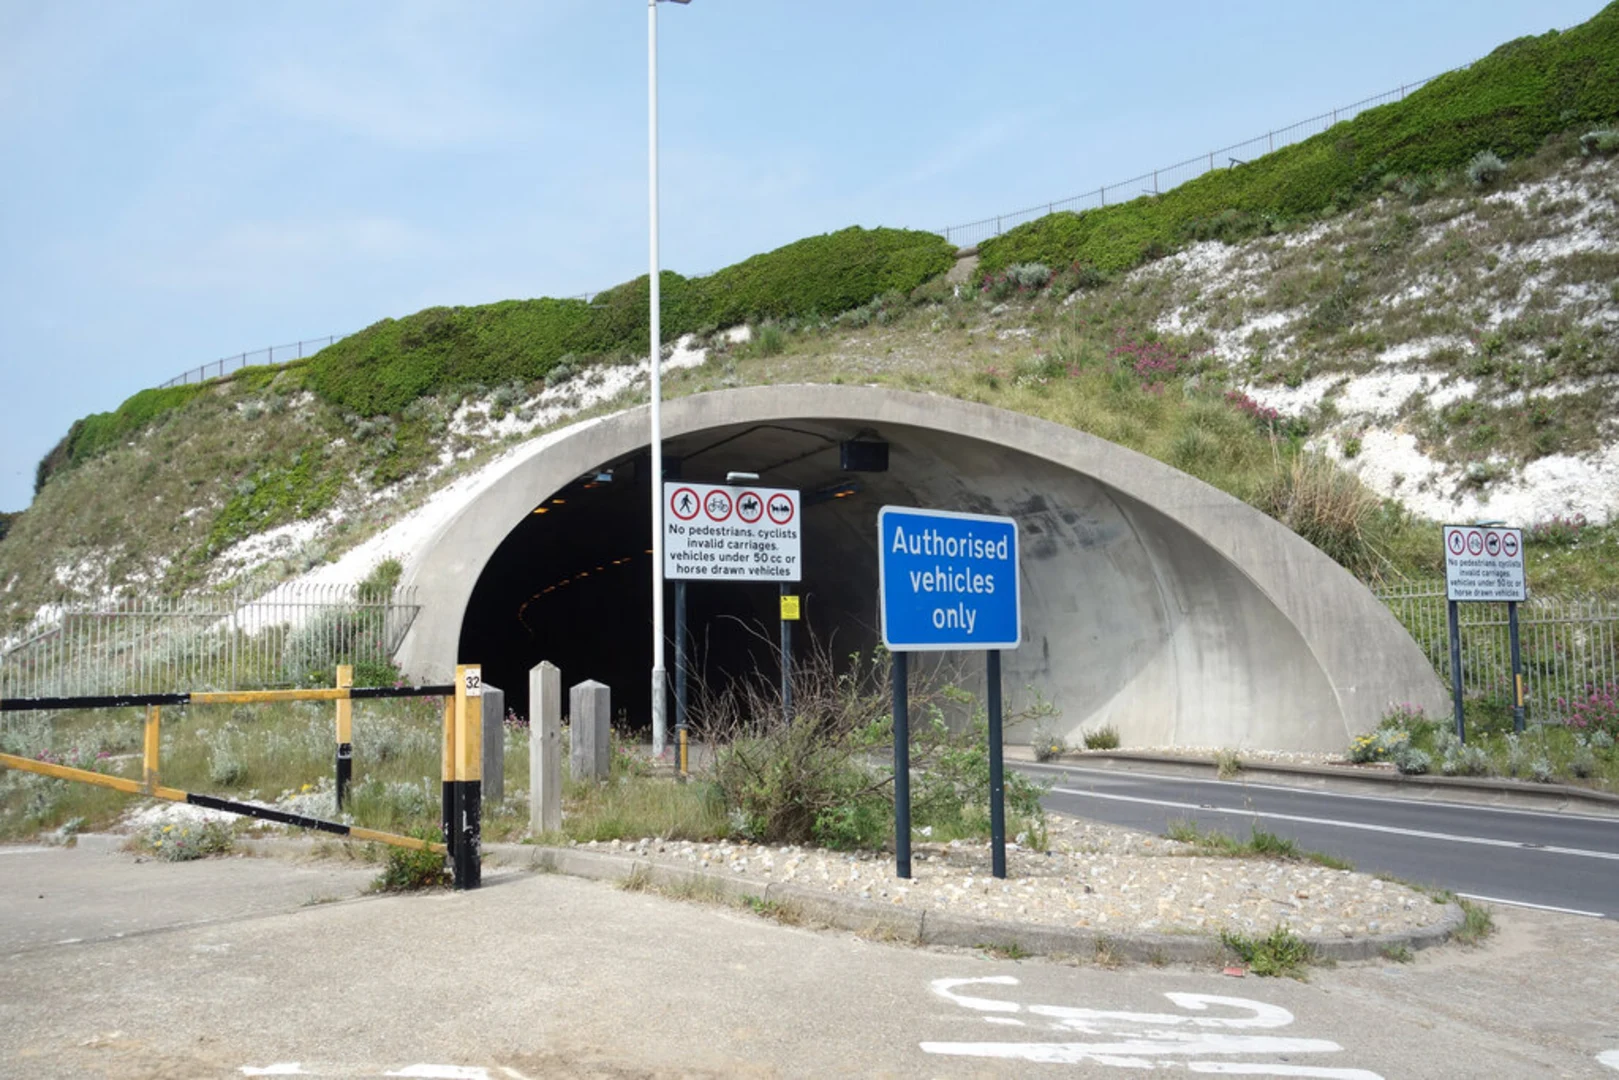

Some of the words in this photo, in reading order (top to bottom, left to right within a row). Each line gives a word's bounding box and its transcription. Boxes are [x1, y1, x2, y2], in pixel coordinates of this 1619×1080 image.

[668, 523, 685, 535] No
[758, 527, 797, 540] cyclists
[687, 537, 724, 549] invalid
[892, 526, 1008, 560] Authorised
[669, 551, 715, 562] vehicles
[719, 552, 750, 563] under
[754, 552, 768, 563] 50
[770, 555, 782, 563] cc
[785, 555, 796, 564] or
[676, 564, 708, 575] horse
[711, 565, 745, 575] drawn
[748, 566, 791, 576] vehicles
[909, 565, 995, 594] vehicles
[932, 602, 977, 635] only
[466, 676, 480, 690] 32
